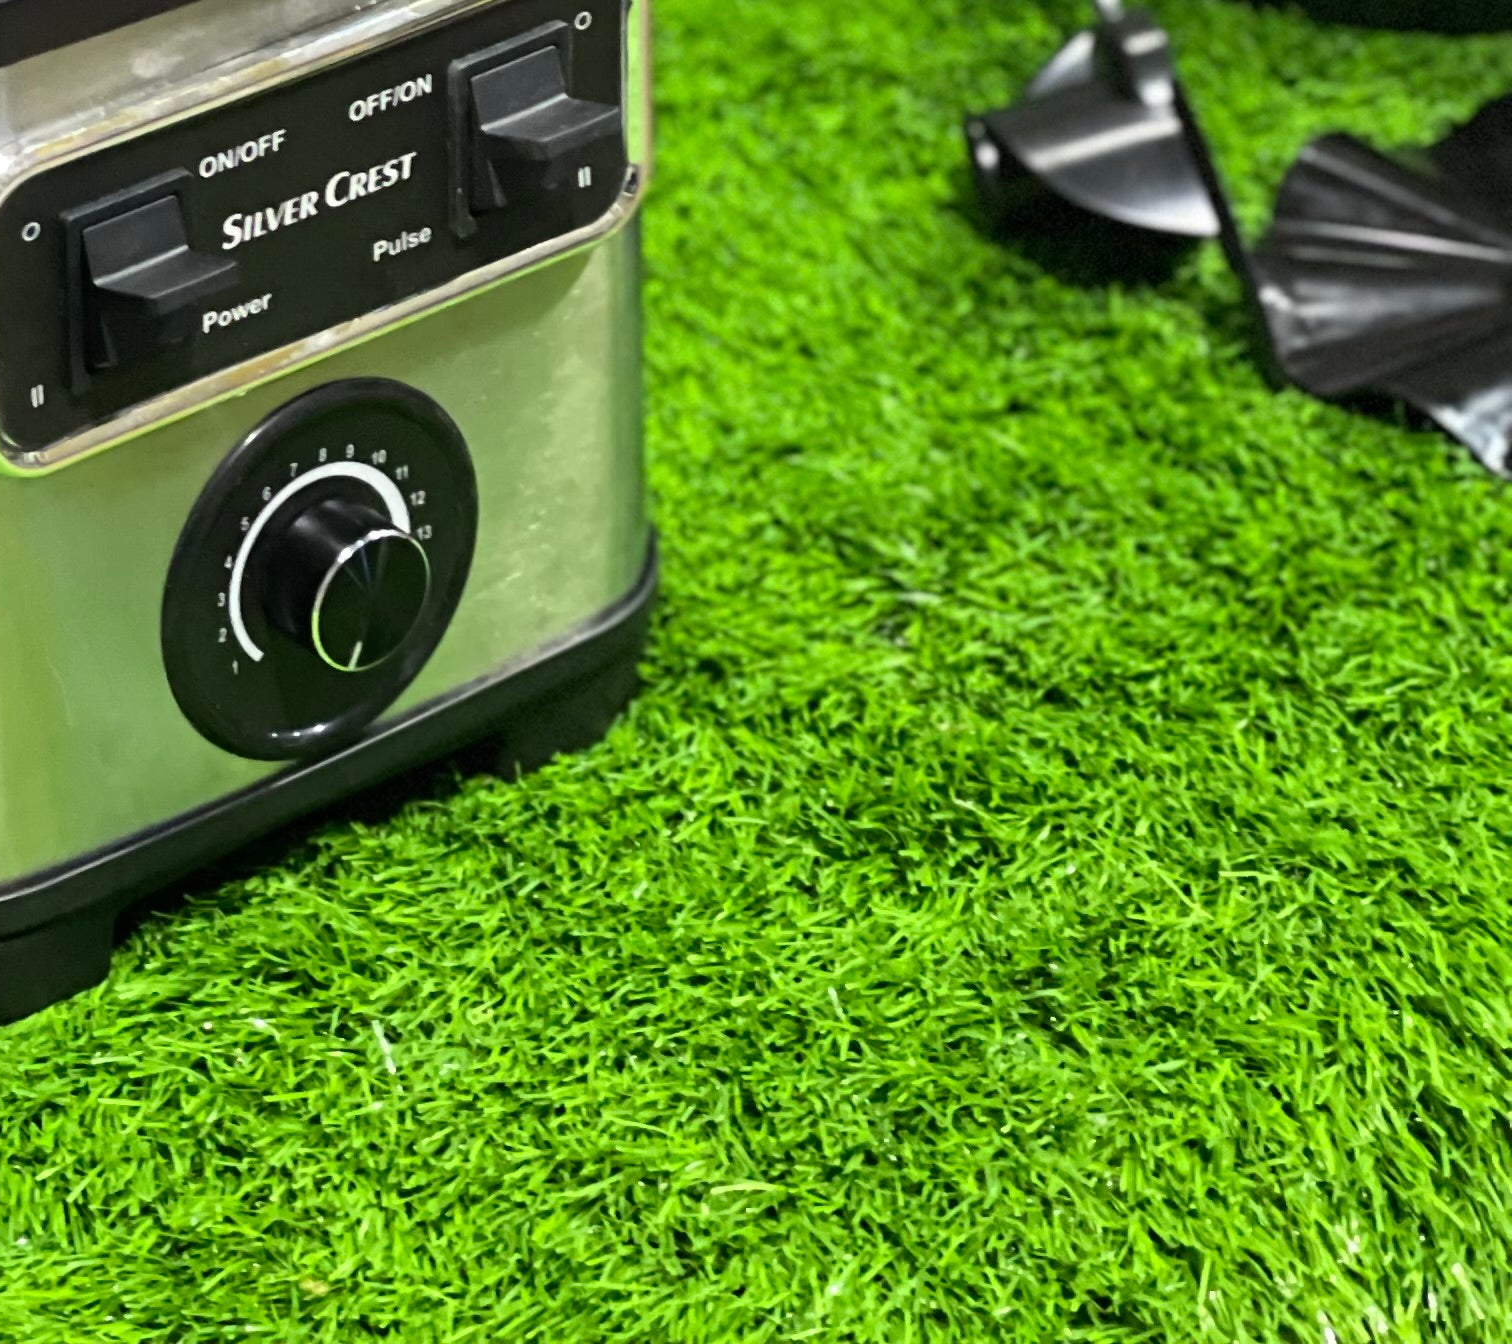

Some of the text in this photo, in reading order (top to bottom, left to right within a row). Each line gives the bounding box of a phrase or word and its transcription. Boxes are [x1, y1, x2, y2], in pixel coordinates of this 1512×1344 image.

[348, 73, 433, 122] OFF/ON
[198, 128, 287, 178] ON/OFF
[221, 151, 418, 250] SILVER CREST
[373, 226, 433, 262] Pulse
[201, 293, 273, 334] Power
[318, 447, 328, 462] 8
[345, 443, 355, 459] 9
[371, 449, 387, 464] 10
[290, 462, 298, 477] 7
[395, 465, 409, 480] 11
[262, 486, 272, 501] 6
[410, 490, 426, 506] 12
[241, 516, 250, 531] 5
[416, 525, 432, 540] 13
[224, 555, 233, 570] 4
[217, 592, 226, 607] 3
[218, 628, 227, 643] 2
[232, 660, 239, 675] 1
